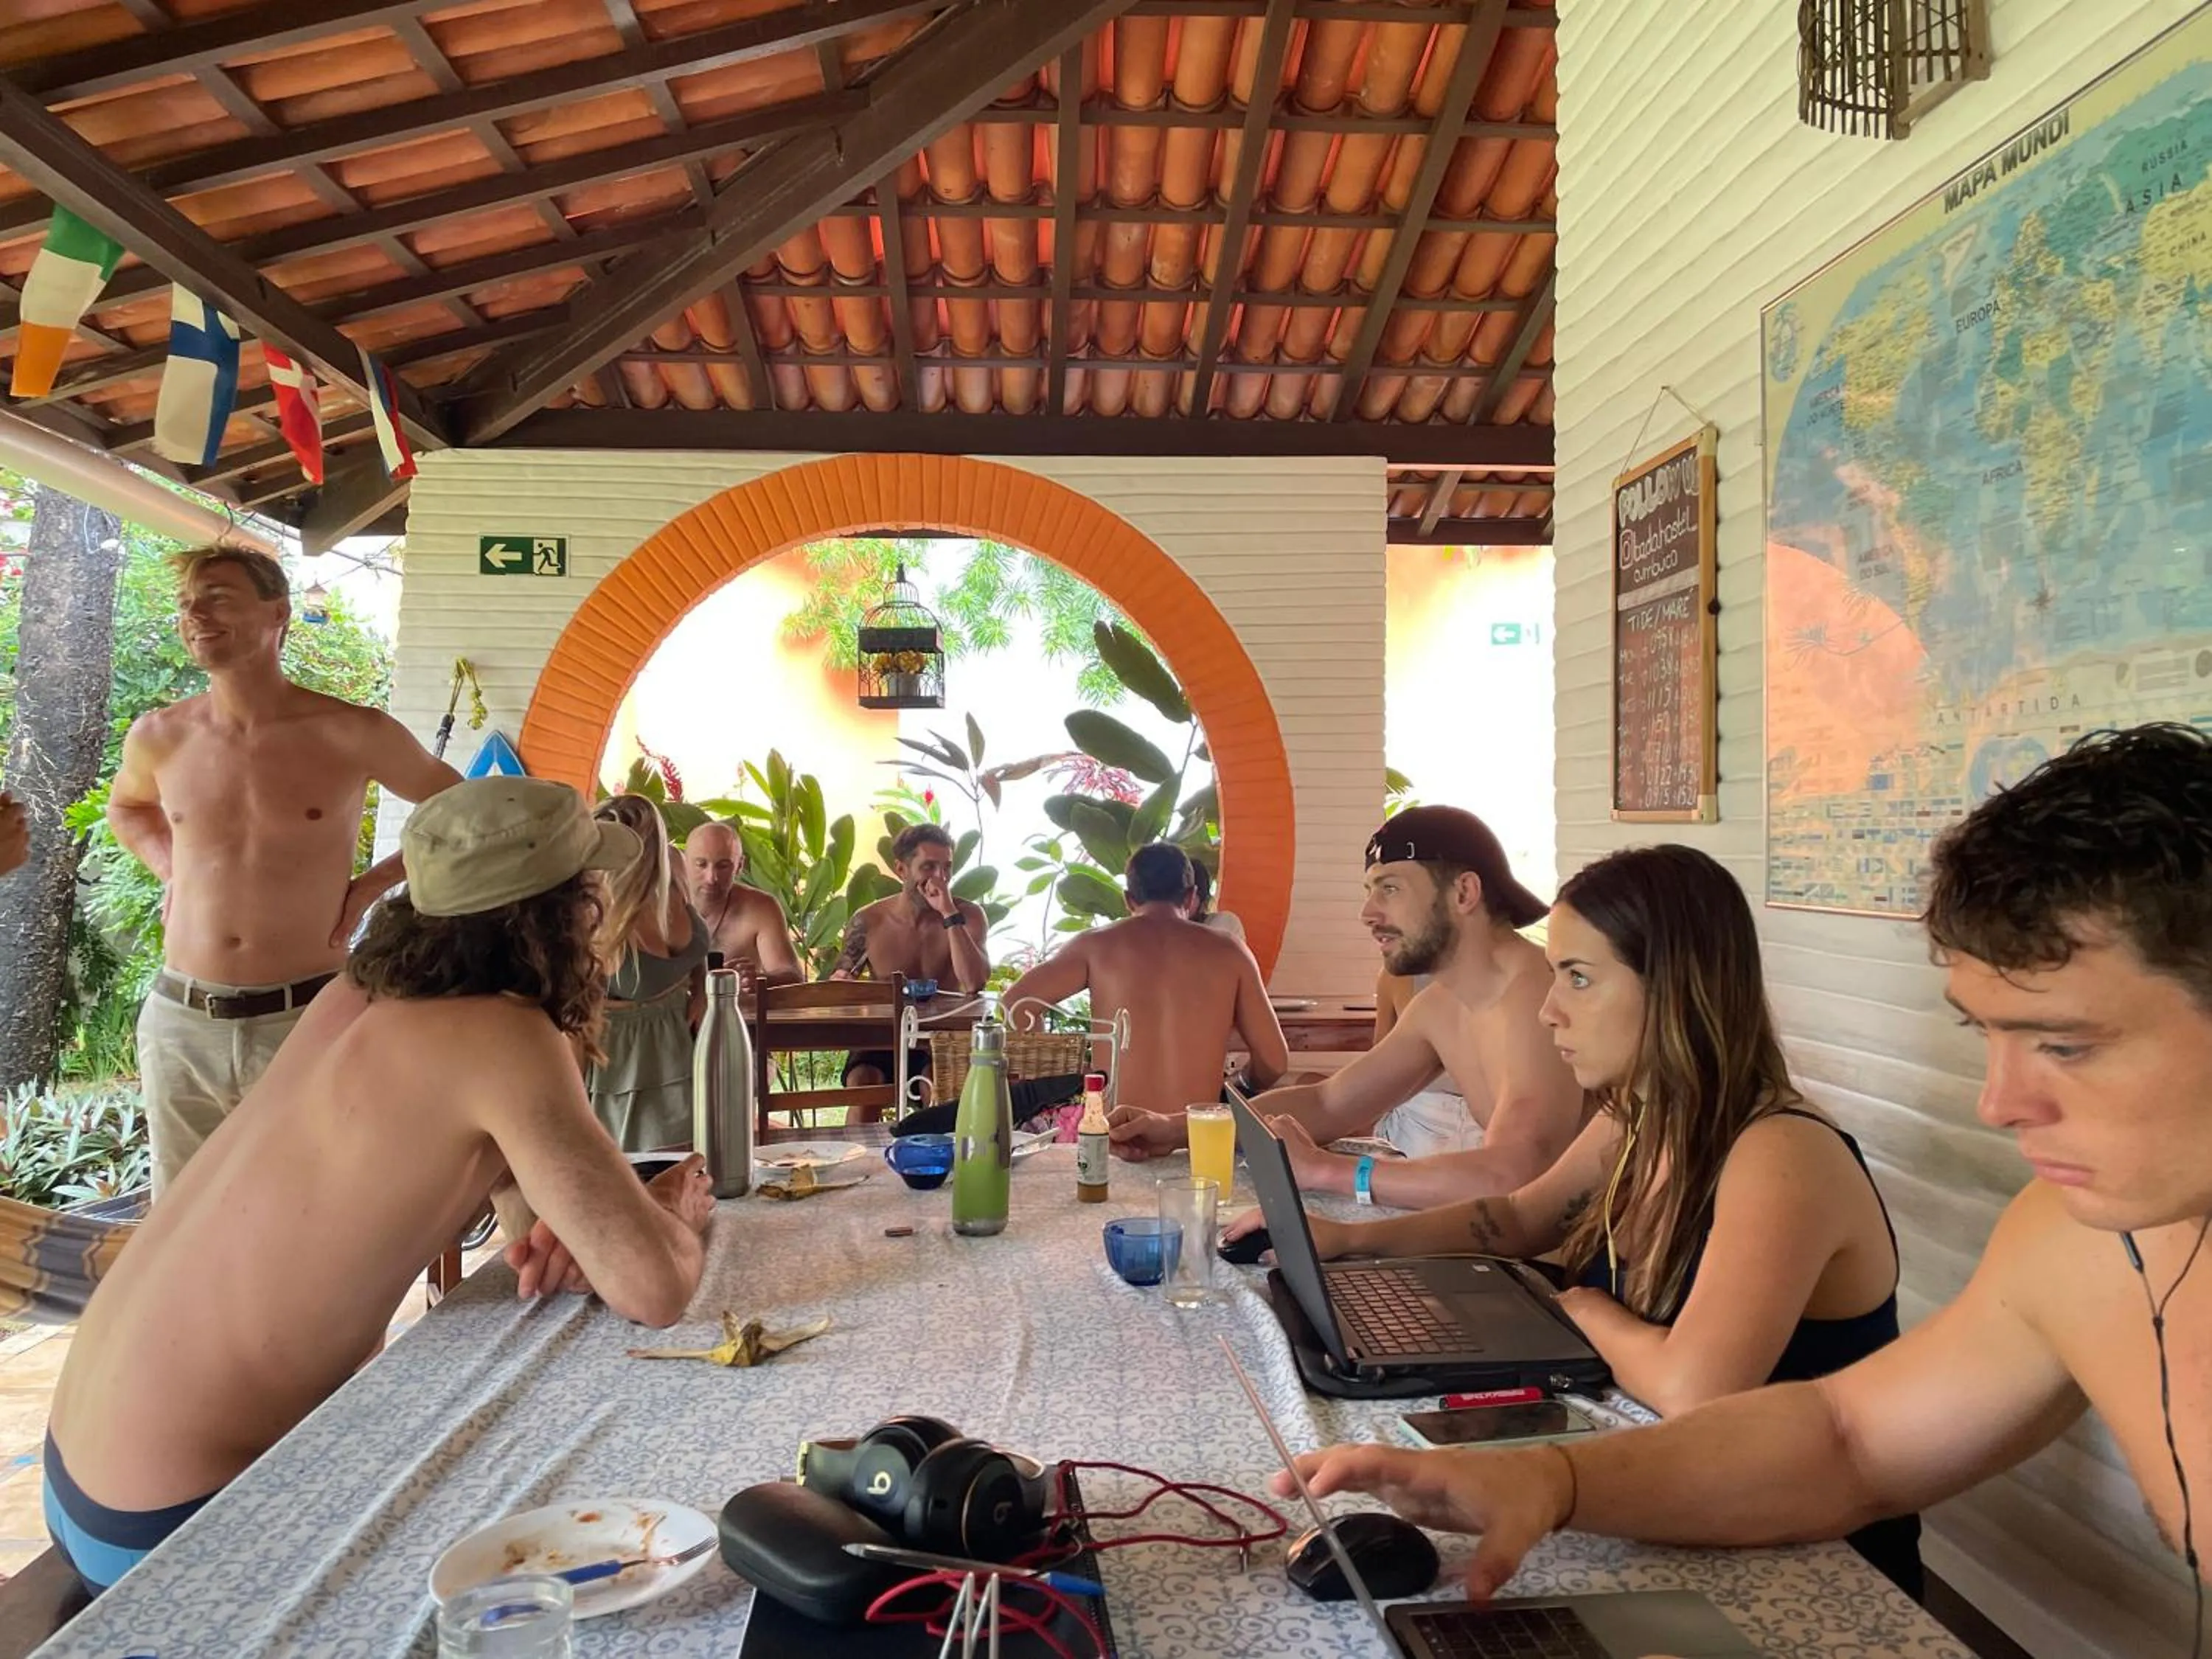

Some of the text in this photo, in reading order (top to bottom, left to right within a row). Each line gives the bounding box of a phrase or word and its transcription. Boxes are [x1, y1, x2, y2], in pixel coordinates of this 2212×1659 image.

[1944, 107, 2069, 214] MAPA MUNDI
[1955, 298, 2000, 334] EUROPA
